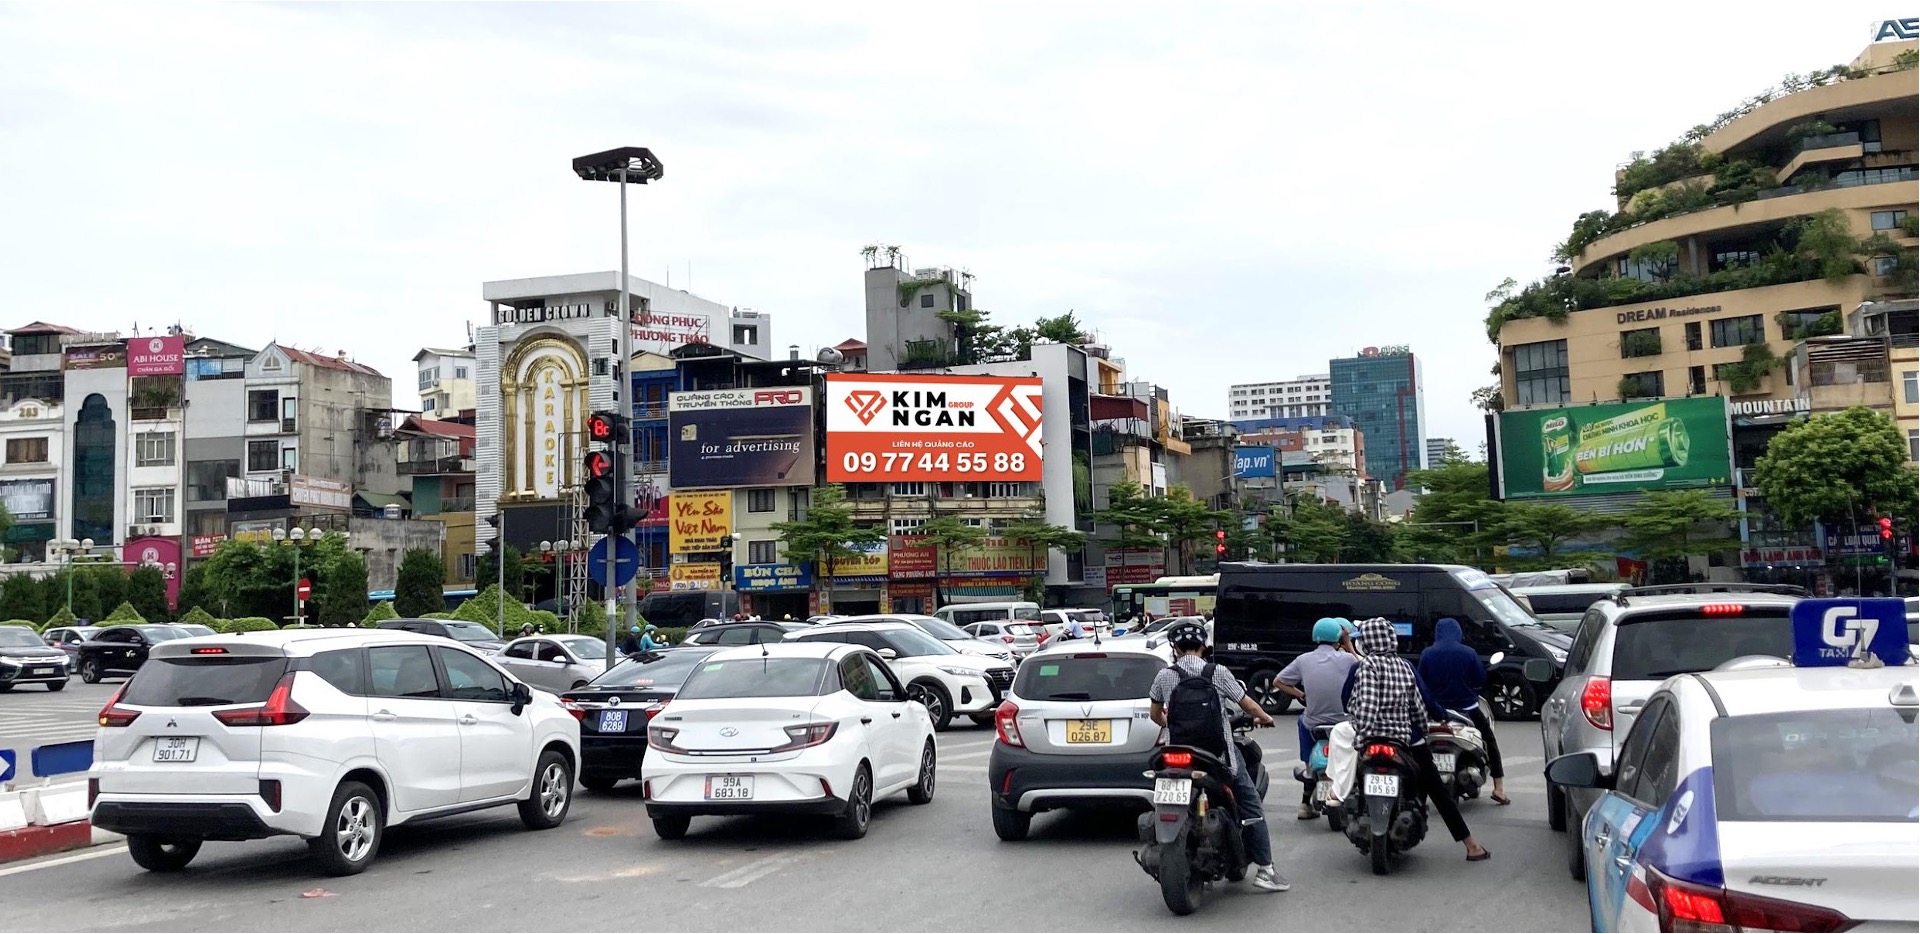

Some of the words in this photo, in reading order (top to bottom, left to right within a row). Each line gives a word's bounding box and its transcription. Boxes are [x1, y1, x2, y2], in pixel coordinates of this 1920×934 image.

[498, 307, 541, 323] GOLDEN
[545, 304, 590, 319] CROWN
[1617, 308, 1667, 324] DREAM
[1669, 305, 1722, 317] Residences
[133, 355, 148, 363] ABI
[150, 354, 179, 362] HOUSE
[754, 390, 803, 406] PRO
[892, 391, 946, 408] KIM
[1730, 398, 1810, 415] MOUNTAIN
[892, 410, 975, 426] NGAN
[544, 371, 555, 484] KARAOKE
[1546, 421, 1564, 429] MILO
[1602, 425, 1619, 435] MINH
[1619, 419, 1640, 430] KHOA
[701, 442, 720, 454] for
[725, 440, 800, 453] advertising
[956, 440, 974, 448] CÁO
[843, 452, 877, 472] 09
[881, 452, 914, 472] 77
[917, 452, 950, 472] 44
[956, 452, 988, 473] 55
[993, 452, 1025, 473] 88
[700, 518, 728, 536] Nam
[1026, 555, 1046, 569] LNG
[744, 566, 771, 577] BÚN
[1823, 606, 1879, 658] G7
[1818, 648, 1849, 658] TAXI
[602, 722, 623, 731] 6289
[1080, 720, 1098, 731] 29E
[1071, 732, 1106, 741] 026.87
[167, 738, 187, 749] 30H
[158, 750, 190, 760] 901.71
[723, 777, 741, 787] 99A
[1370, 775, 1394, 784] 29-L5
[714, 788, 748, 798] 683.18
[1368, 785, 1396, 795] 185.69
[1155, 791, 1188, 802] 720.65
[1748, 875, 1828, 886] ACCENT
